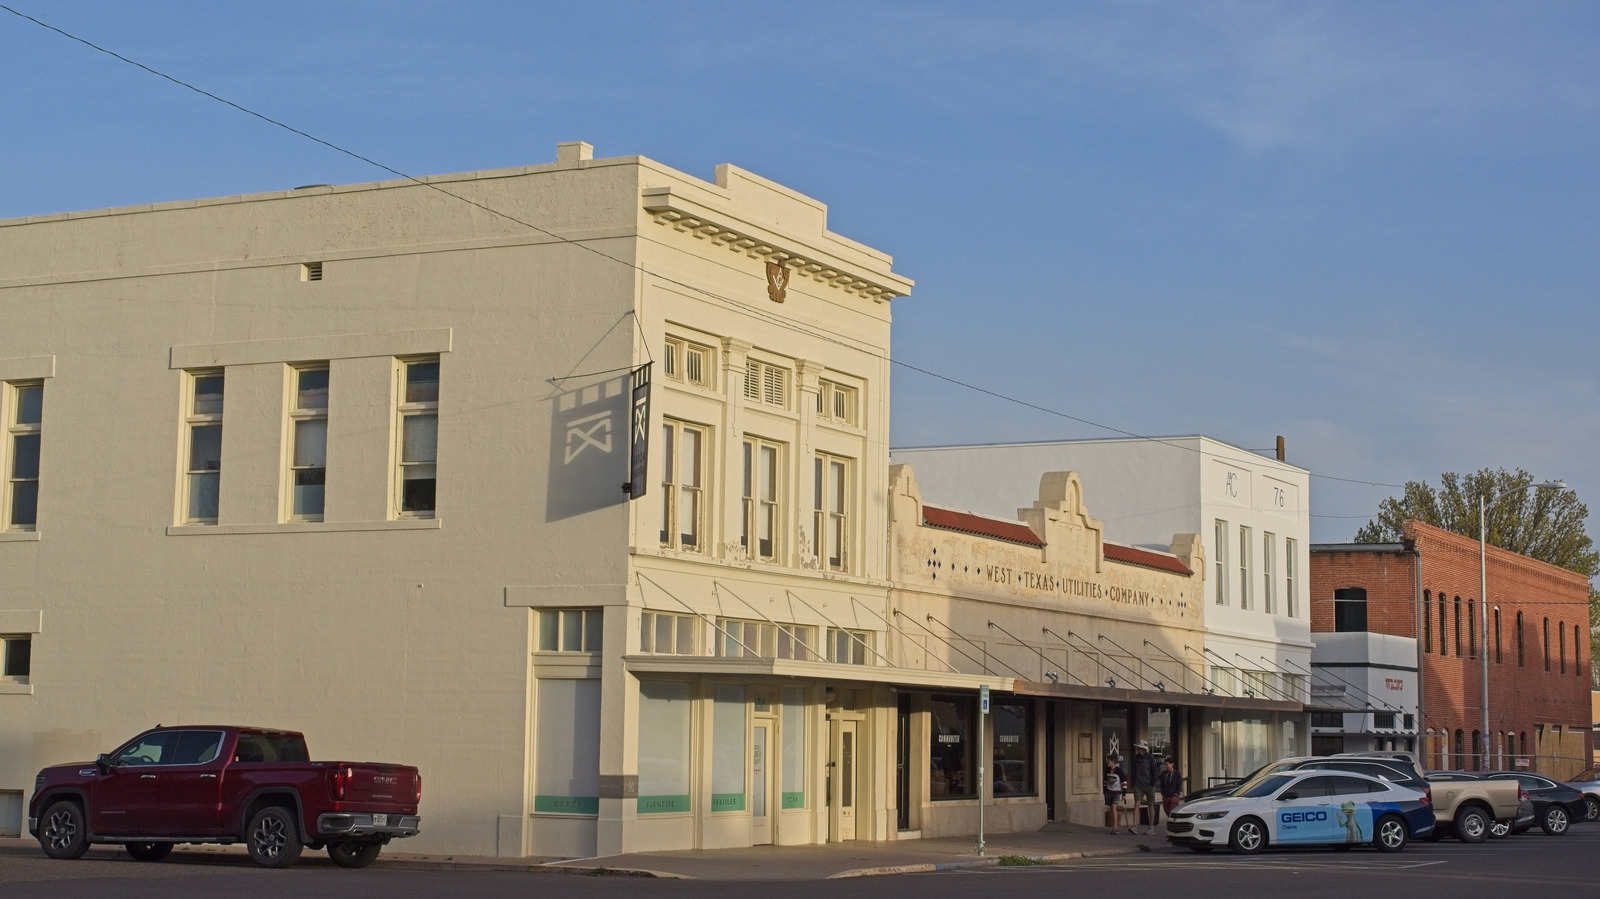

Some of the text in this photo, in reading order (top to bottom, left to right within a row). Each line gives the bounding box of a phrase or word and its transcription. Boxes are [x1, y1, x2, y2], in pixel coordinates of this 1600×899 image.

[1273, 486, 1285, 508] 76
[986, 564, 1150, 607] WEST TEXAS UTILITIES COMPANY
[1281, 811, 1327, 823] GEICO
